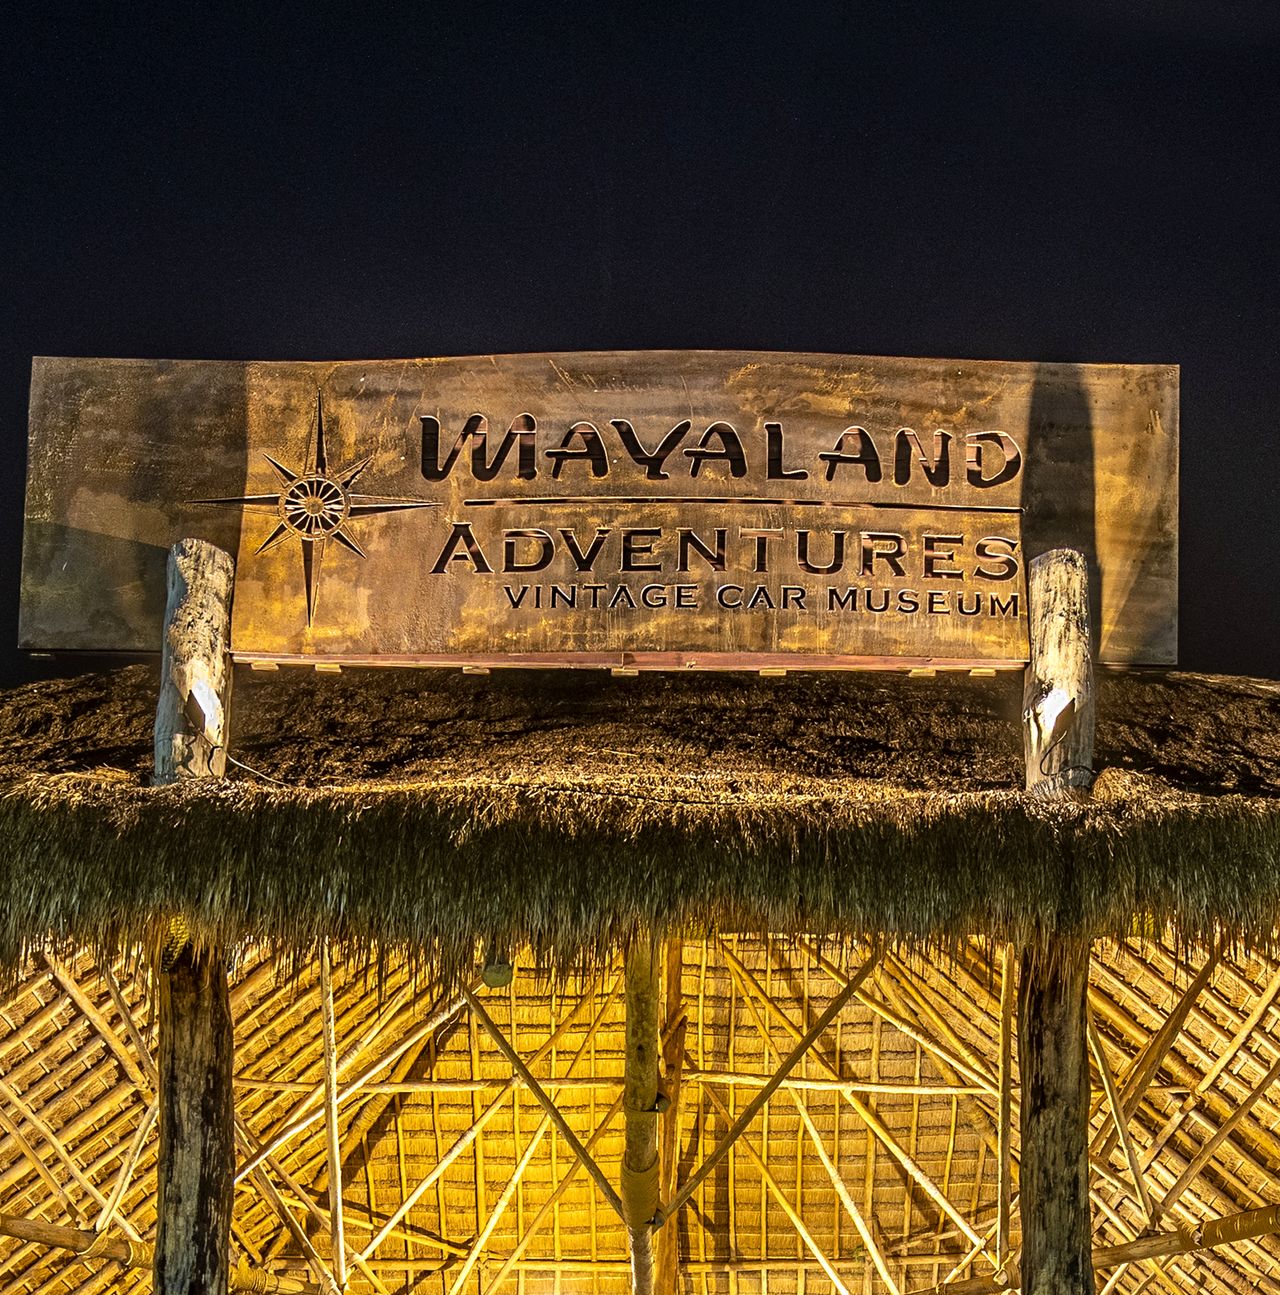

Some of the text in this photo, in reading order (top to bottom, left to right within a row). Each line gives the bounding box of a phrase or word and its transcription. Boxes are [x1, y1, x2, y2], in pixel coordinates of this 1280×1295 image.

[420, 412, 1022, 489] MAYALAND
[428, 522, 1019, 581] ADVENTURES
[503, 584, 1019, 617] VINTAGE CAR MUSEUM
